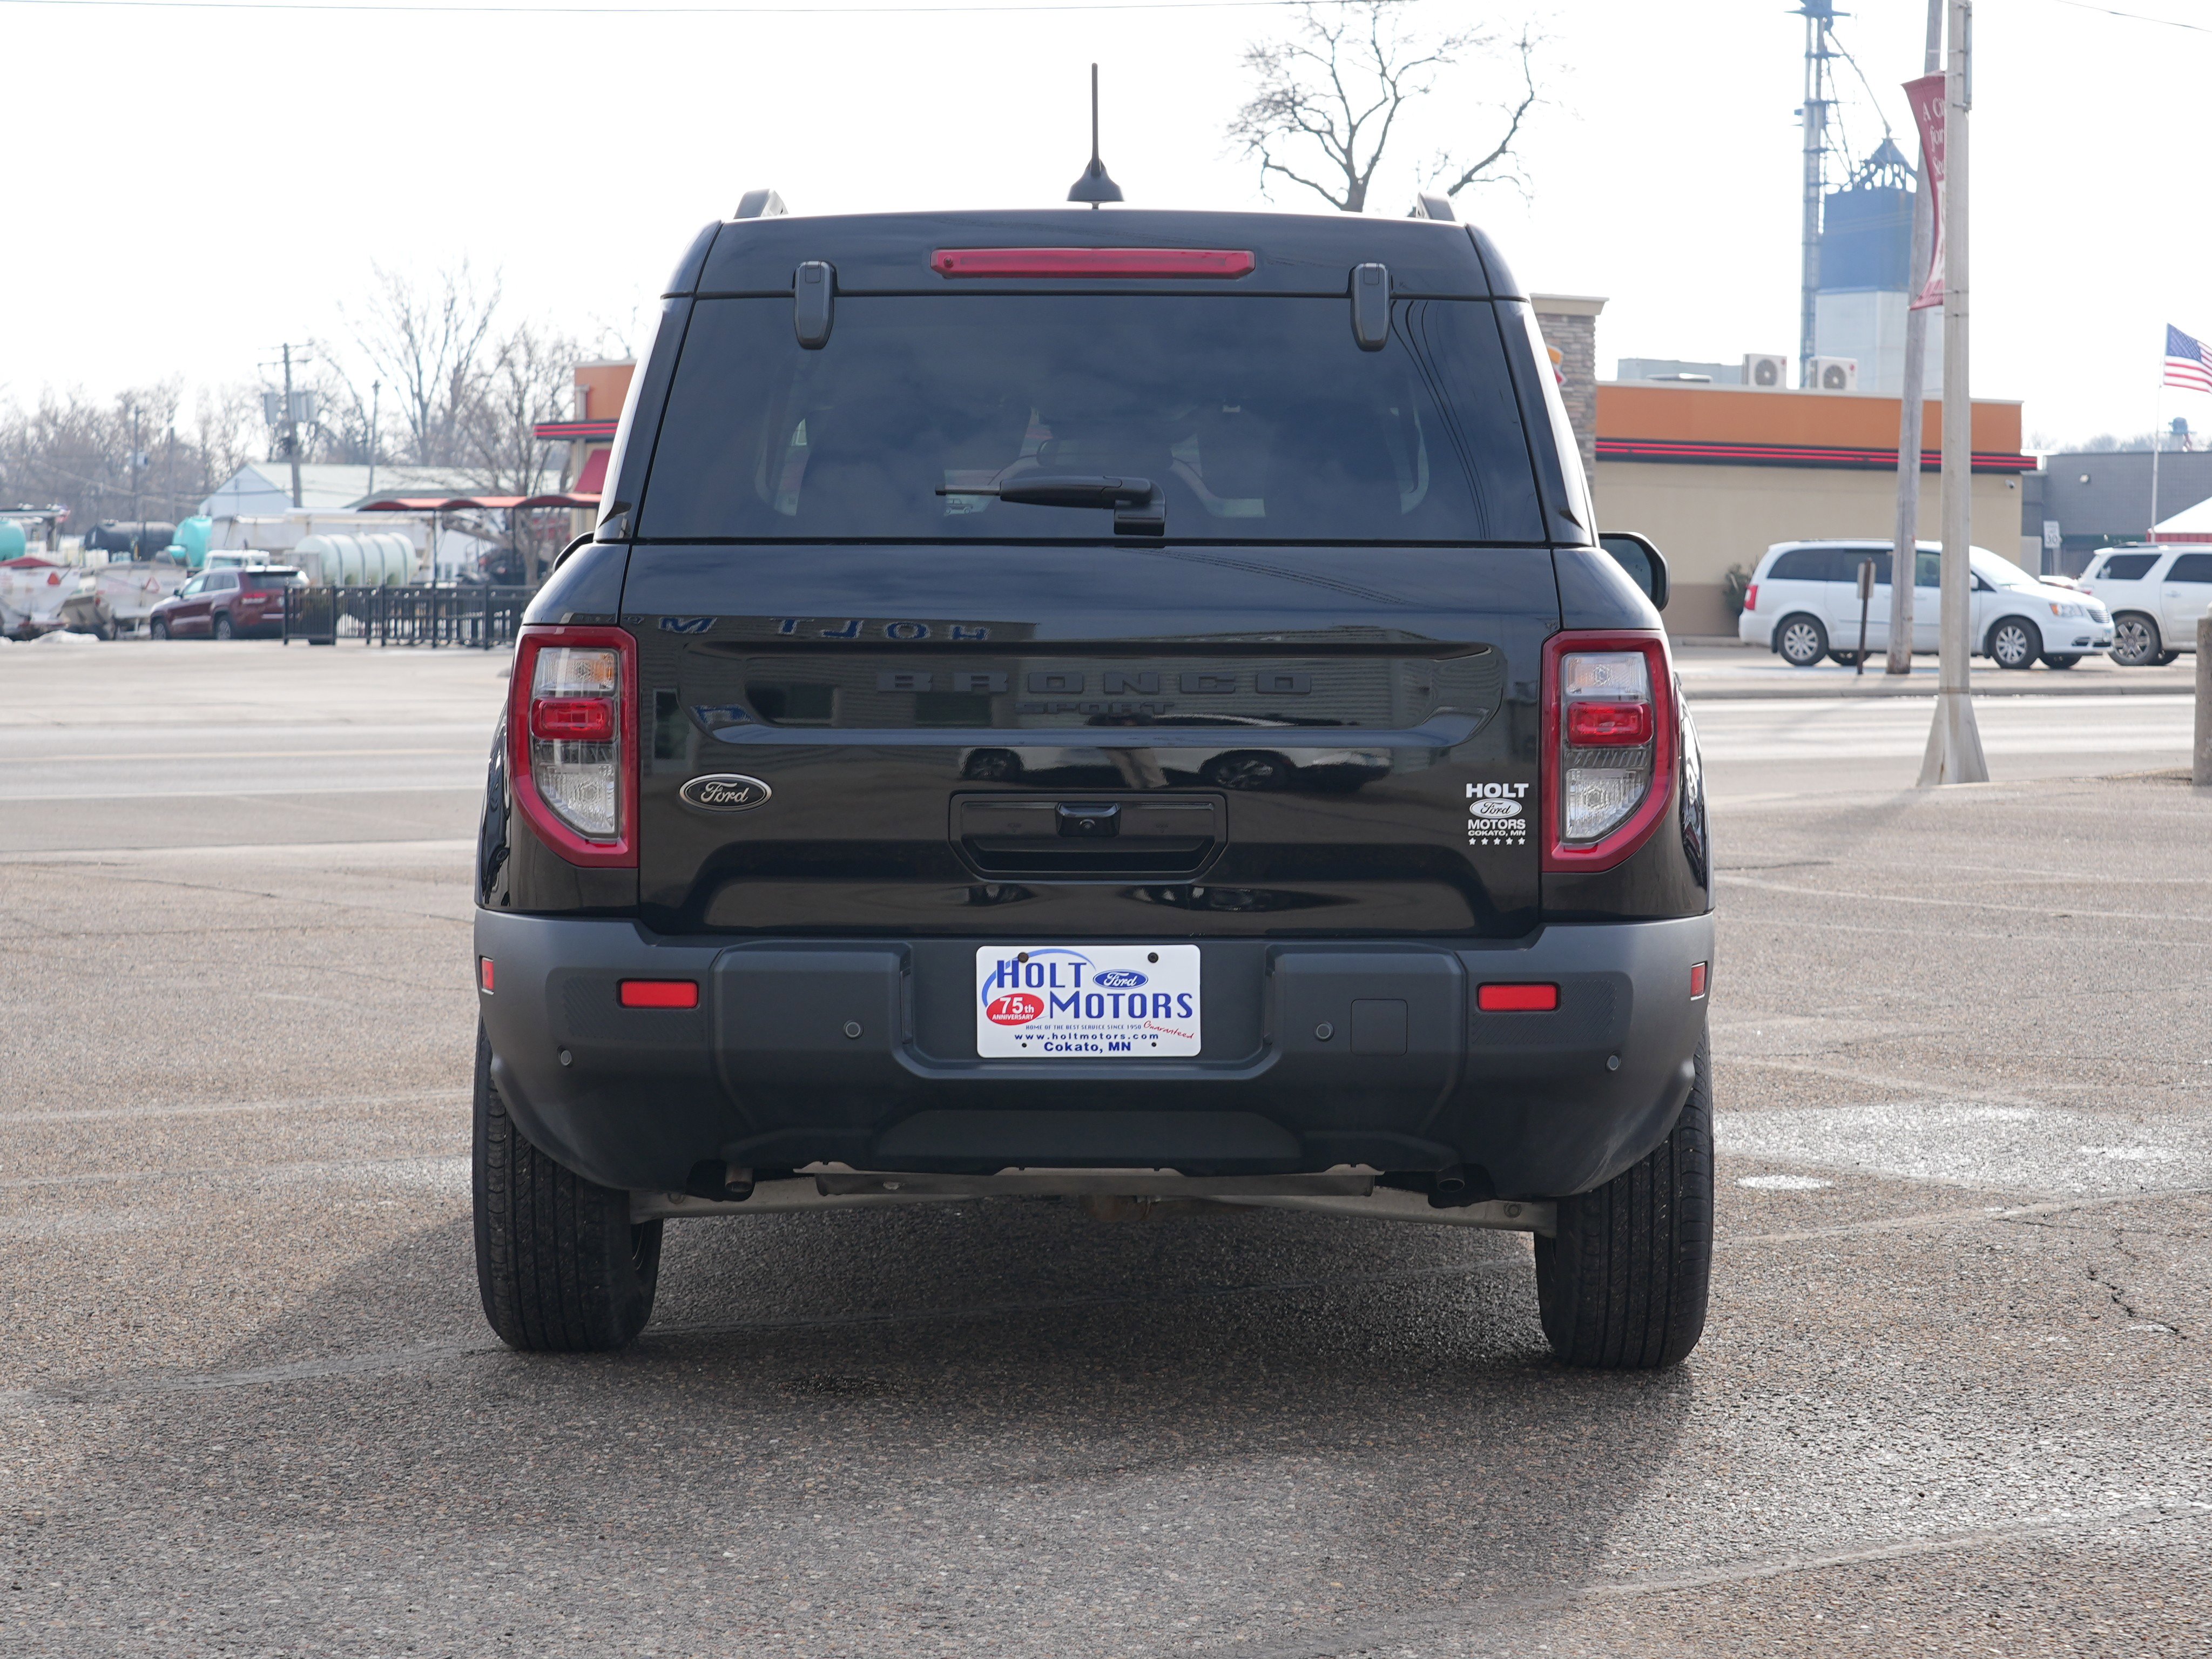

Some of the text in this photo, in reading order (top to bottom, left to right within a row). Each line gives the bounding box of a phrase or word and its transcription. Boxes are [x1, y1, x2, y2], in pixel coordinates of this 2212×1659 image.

[1922, 100, 1932, 122] A
[2046, 534, 2058, 544] 30
[876, 671, 1313, 694] BRONCO
[1014, 700, 1176, 715] SPORT
[700, 781, 750, 803] Ford
[1466, 783, 1529, 798] HOLT
[1480, 801, 1512, 815] Ford
[1467, 819, 1527, 830] MOTORS
[996, 960, 1087, 988] HOLT
[1103, 971, 1138, 987] Ford
[999, 996, 1035, 1014] 75th
[1049, 990, 1193, 1019] MOTORS
[1014, 1032, 1159, 1040] www.holtmotors.com
[1043, 1041, 1131, 1054] Cokato, MN
